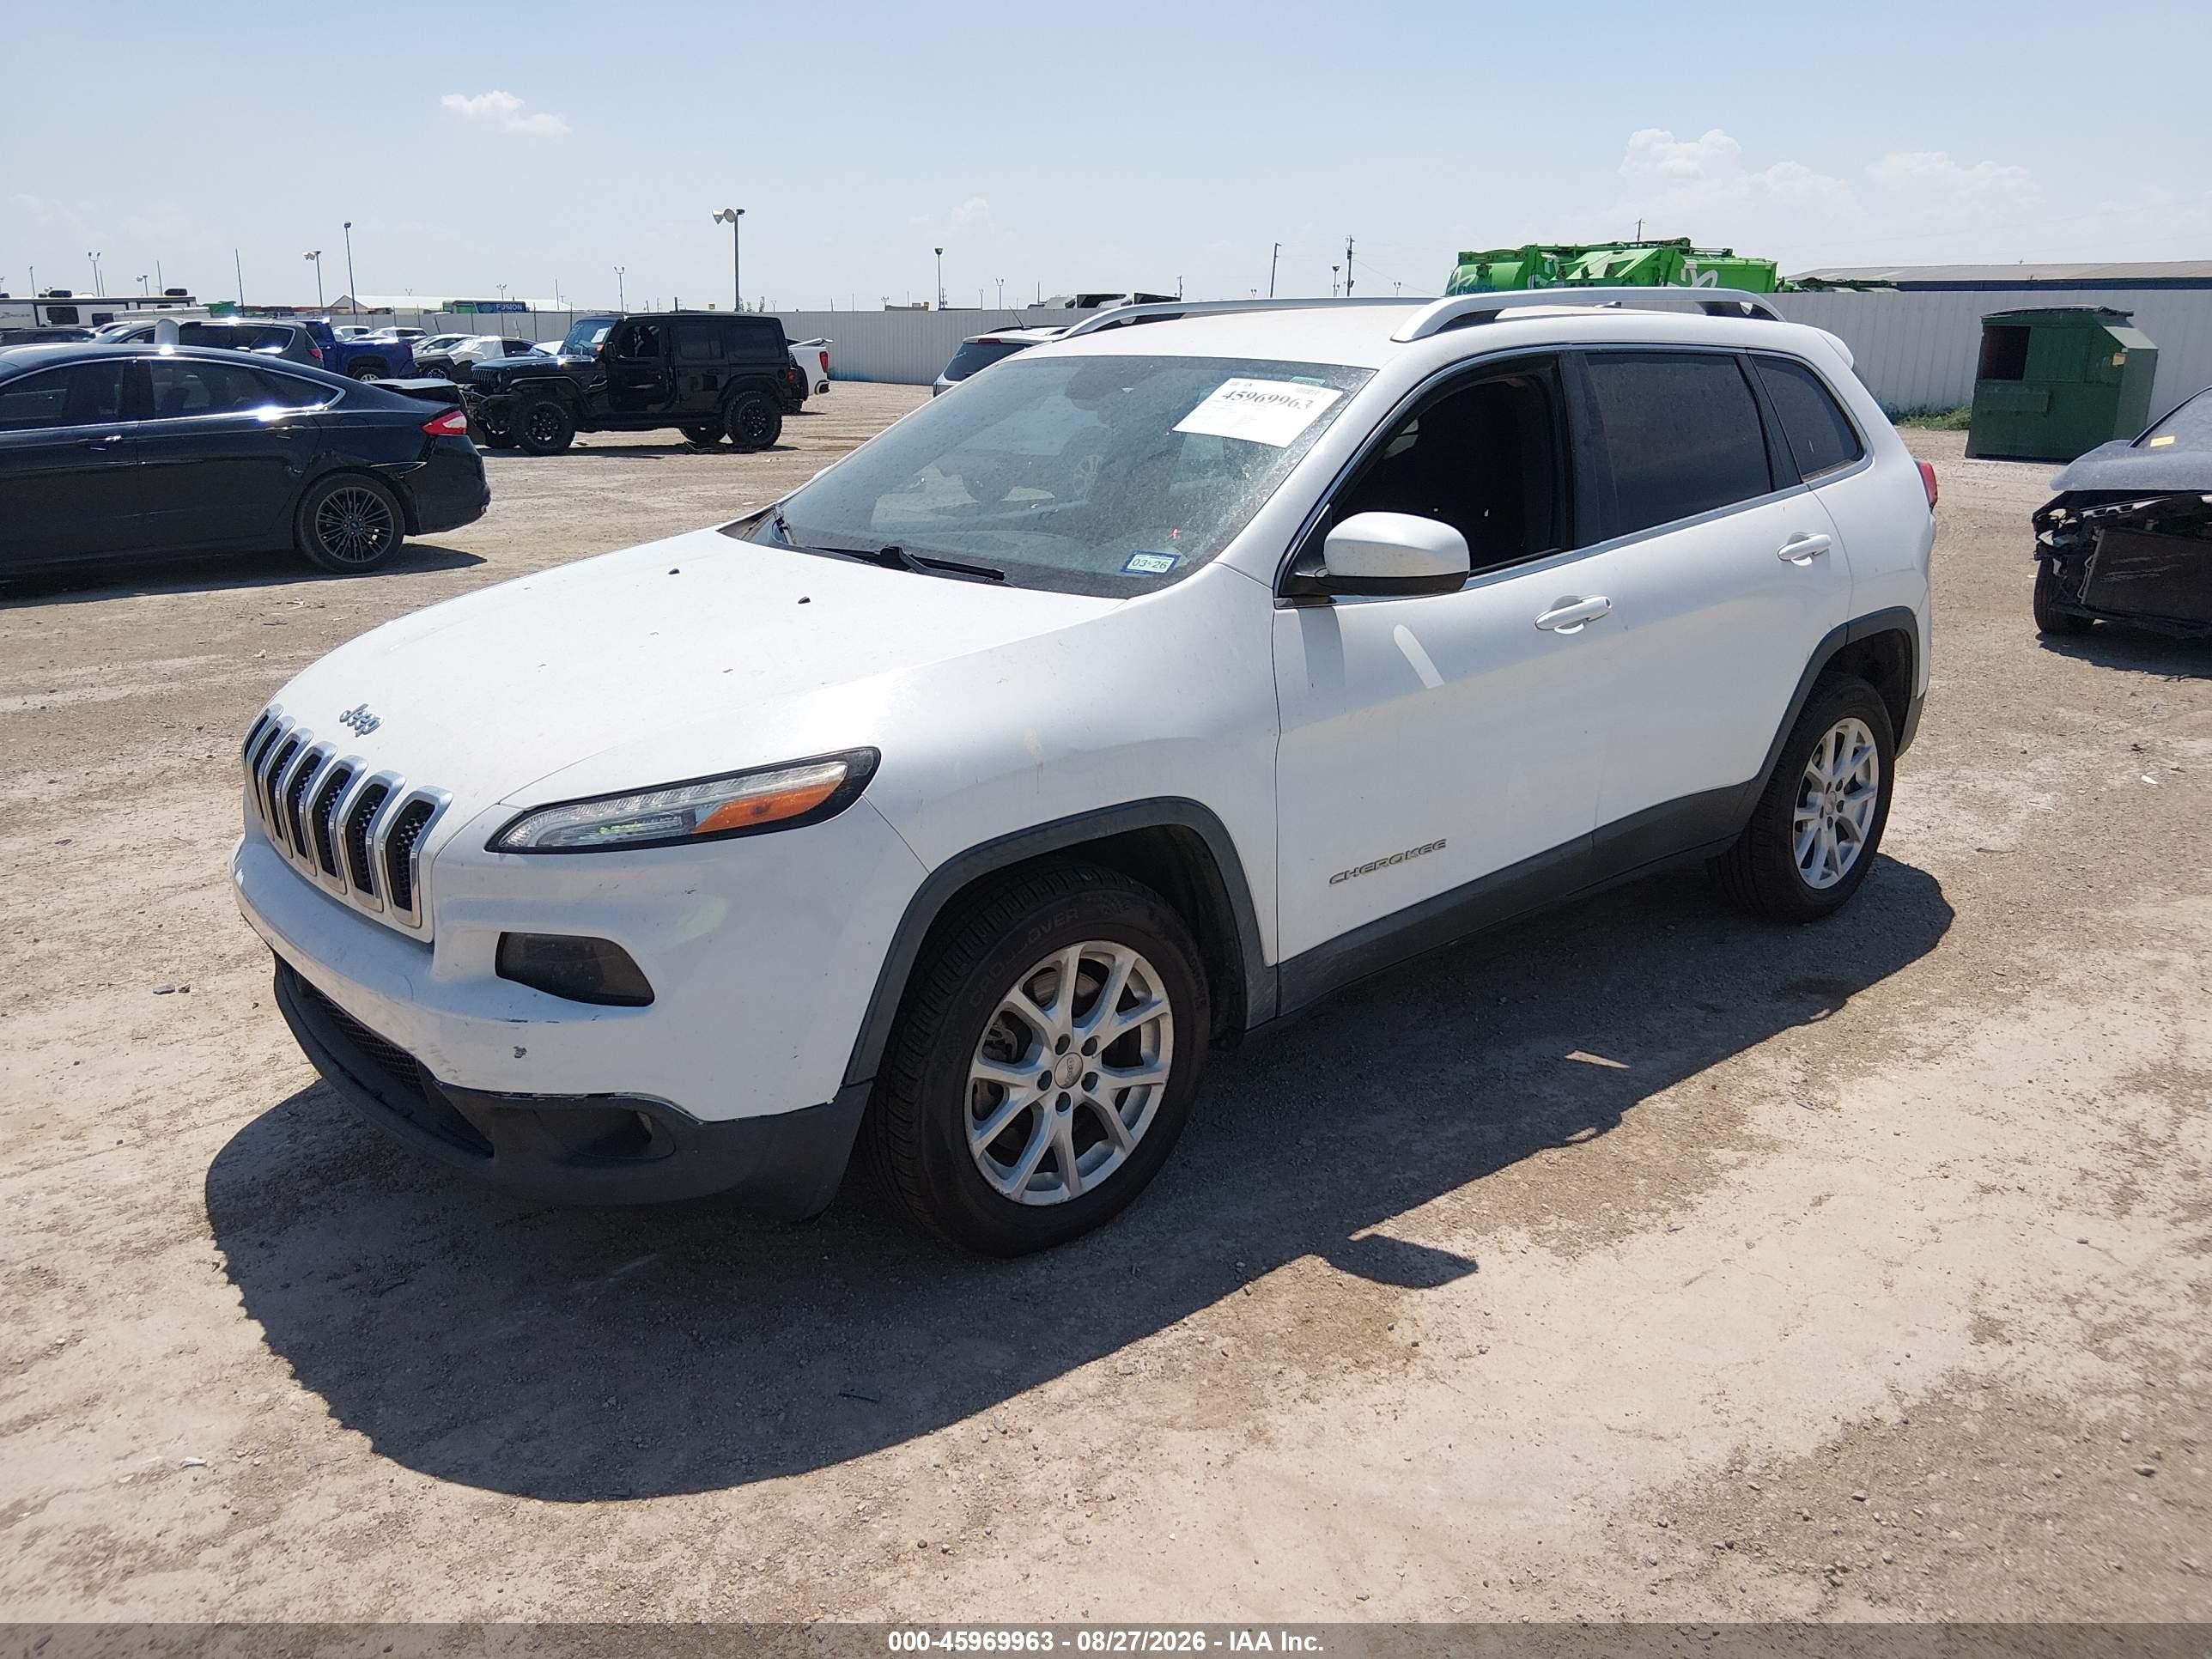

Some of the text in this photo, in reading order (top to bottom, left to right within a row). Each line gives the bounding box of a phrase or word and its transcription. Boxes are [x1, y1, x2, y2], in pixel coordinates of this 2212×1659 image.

[1223, 390, 1314, 410] 45969963
[339, 703, 384, 738] Jeep
[1329, 838, 1447, 884] CHEROKEE
